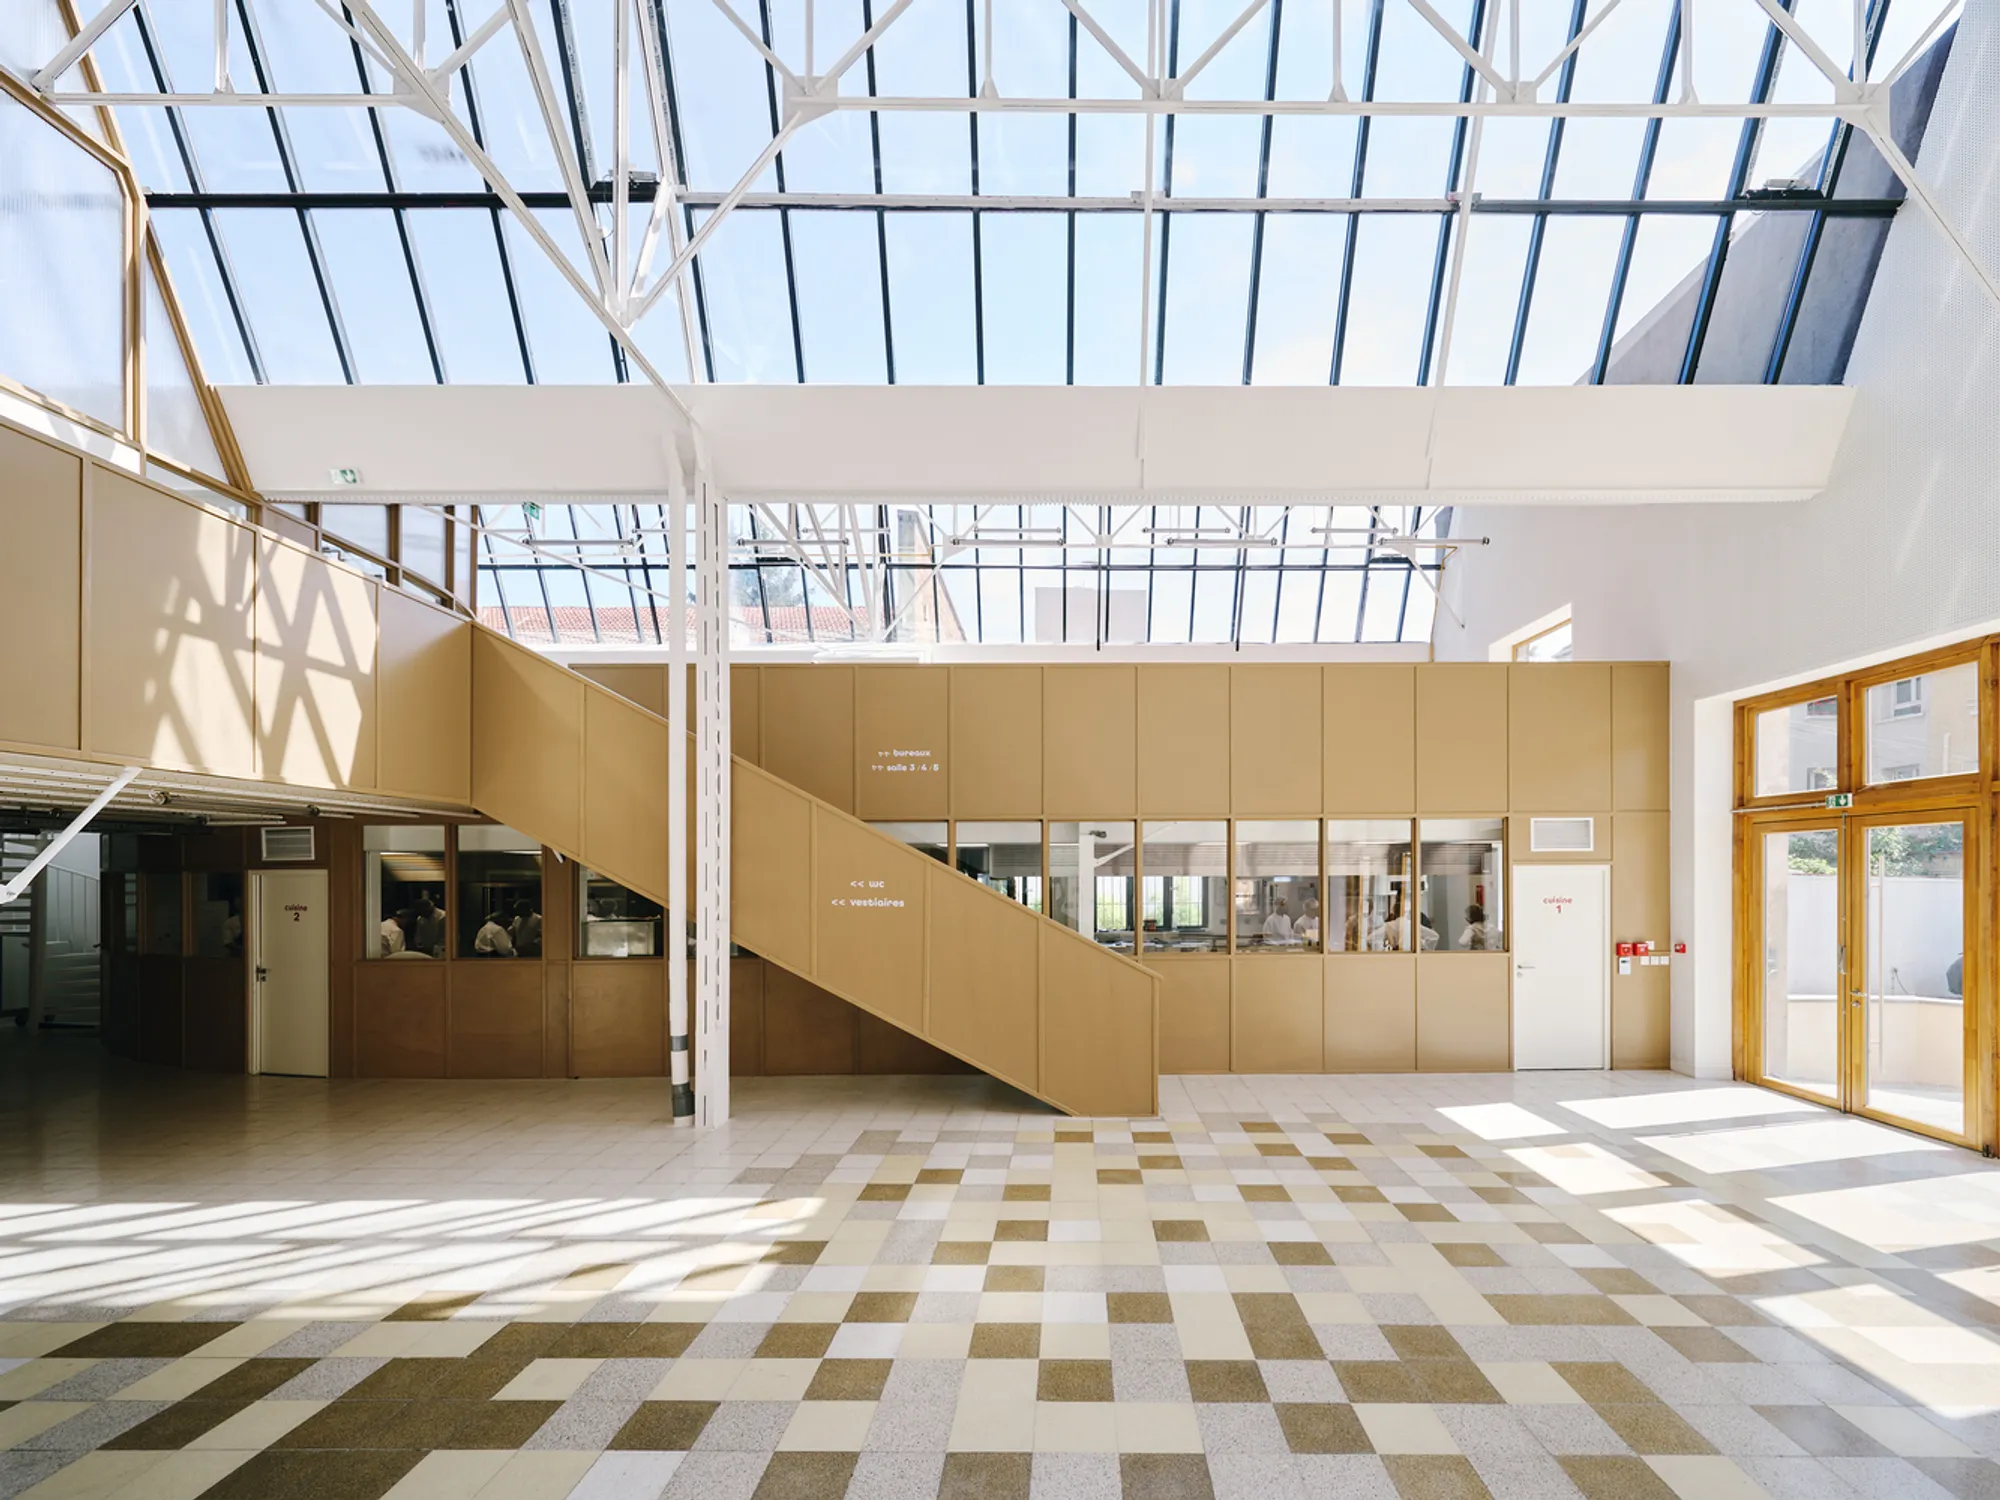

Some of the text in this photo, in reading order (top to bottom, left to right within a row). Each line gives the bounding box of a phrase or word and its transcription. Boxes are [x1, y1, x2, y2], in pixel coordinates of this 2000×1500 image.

[893, 749, 931, 757] bureaux
[868, 880, 885, 888] wc
[850, 898, 905, 907] vestiaires
[1542, 896, 1573, 904] cuisine
[1556, 905, 1562, 914] 1
[293, 912, 300, 922] 2
